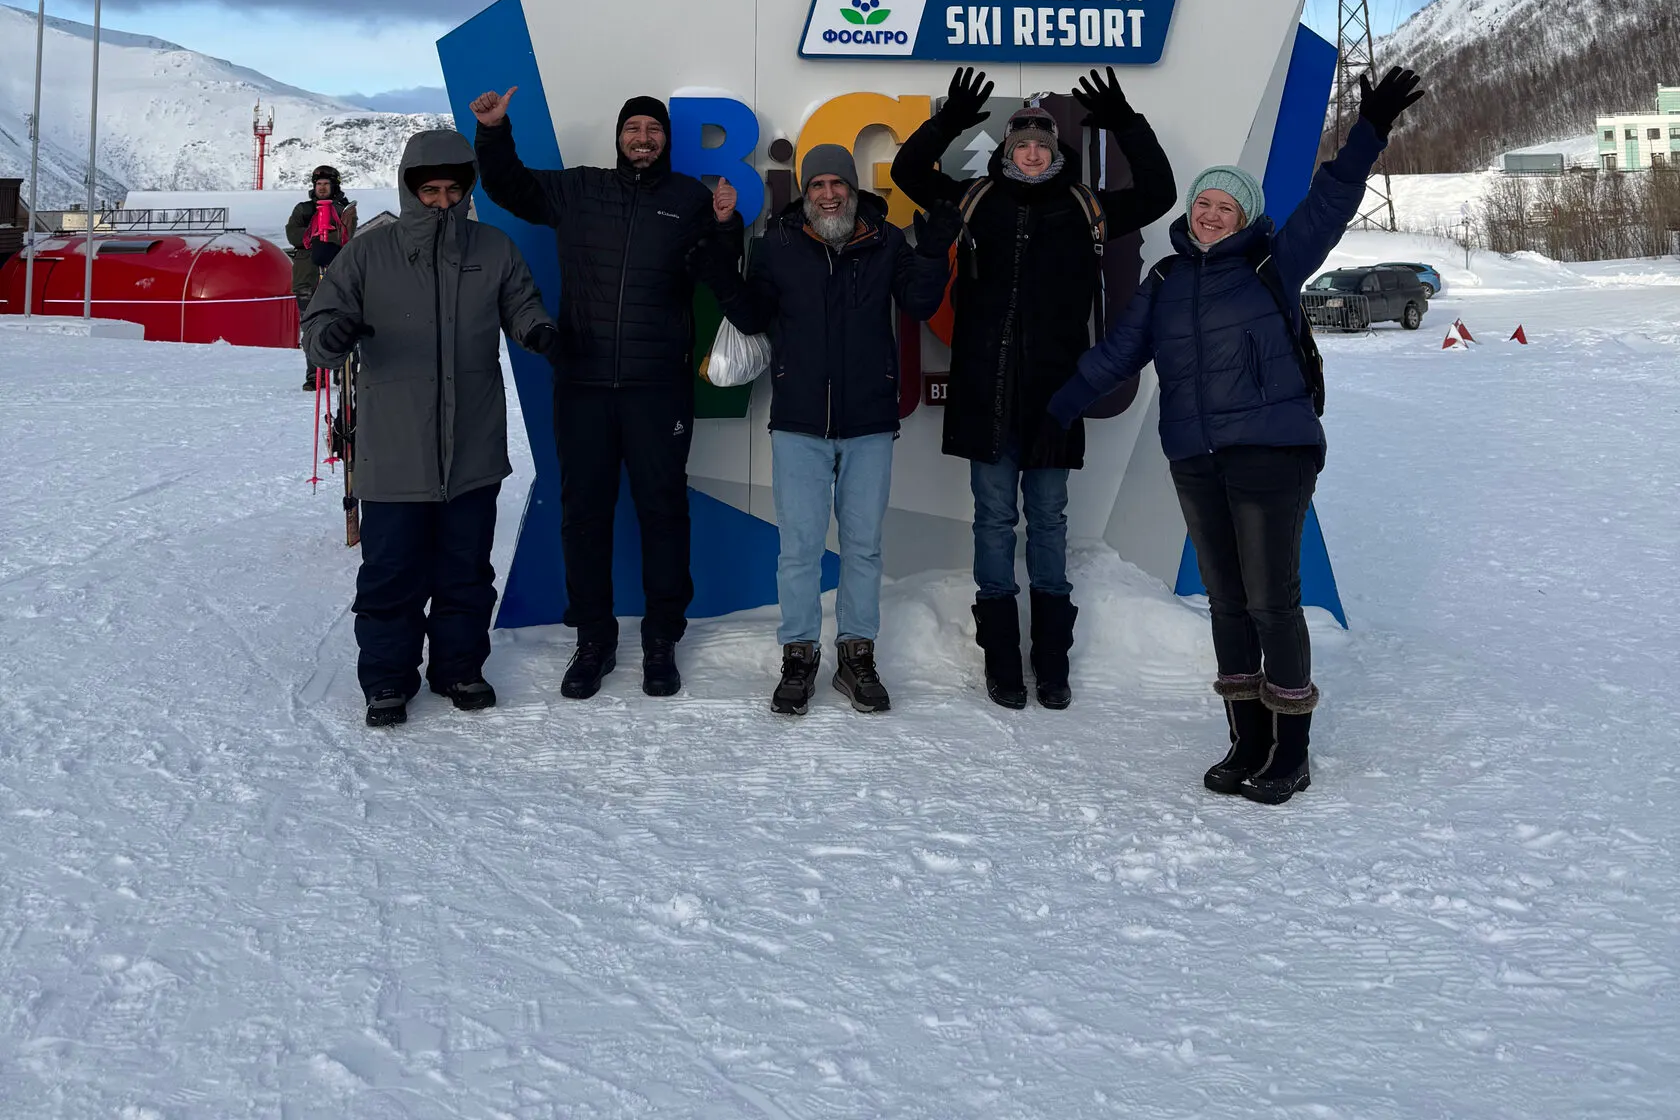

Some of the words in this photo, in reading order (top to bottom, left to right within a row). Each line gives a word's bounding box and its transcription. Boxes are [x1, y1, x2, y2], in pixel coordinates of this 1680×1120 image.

[822, 29, 908, 45] ФОСАГРО
[946, 6, 1002, 46] SKI
[1013, 7, 1145, 48] RESORT
